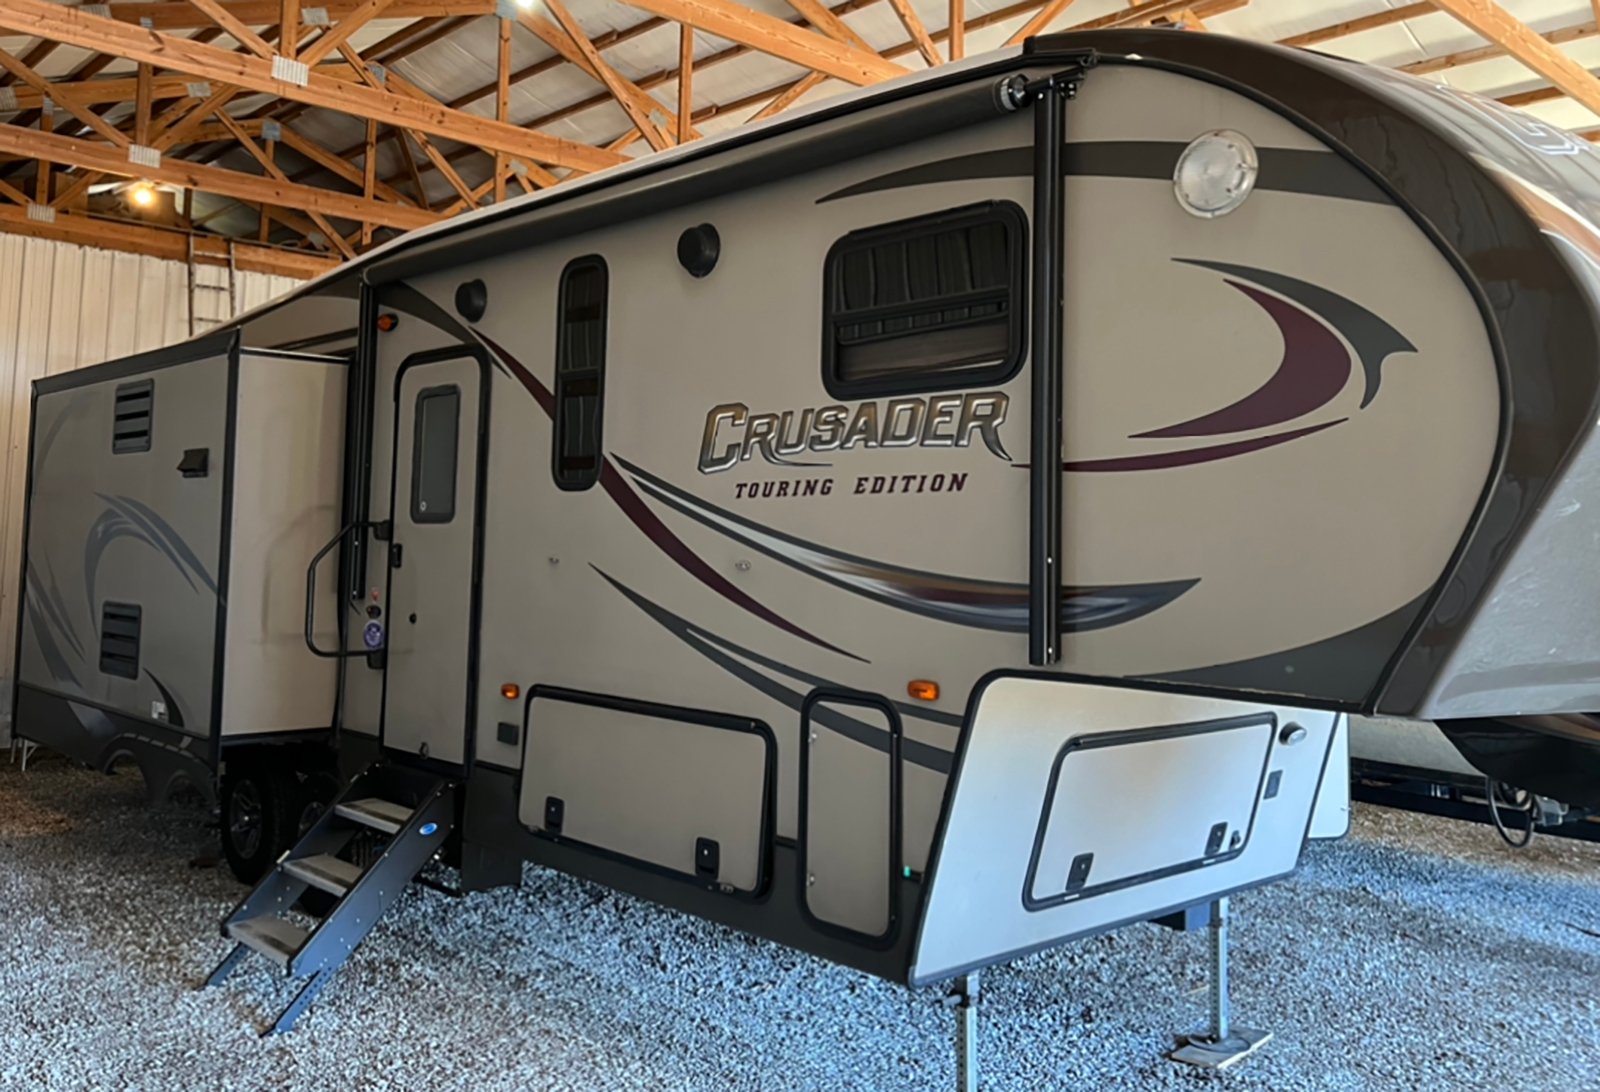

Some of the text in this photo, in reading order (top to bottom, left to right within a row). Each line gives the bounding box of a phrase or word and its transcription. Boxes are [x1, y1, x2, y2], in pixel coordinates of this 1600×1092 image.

[697, 390, 1013, 475] CRUSADER
[735, 473, 968, 499] TOURING EDITION
